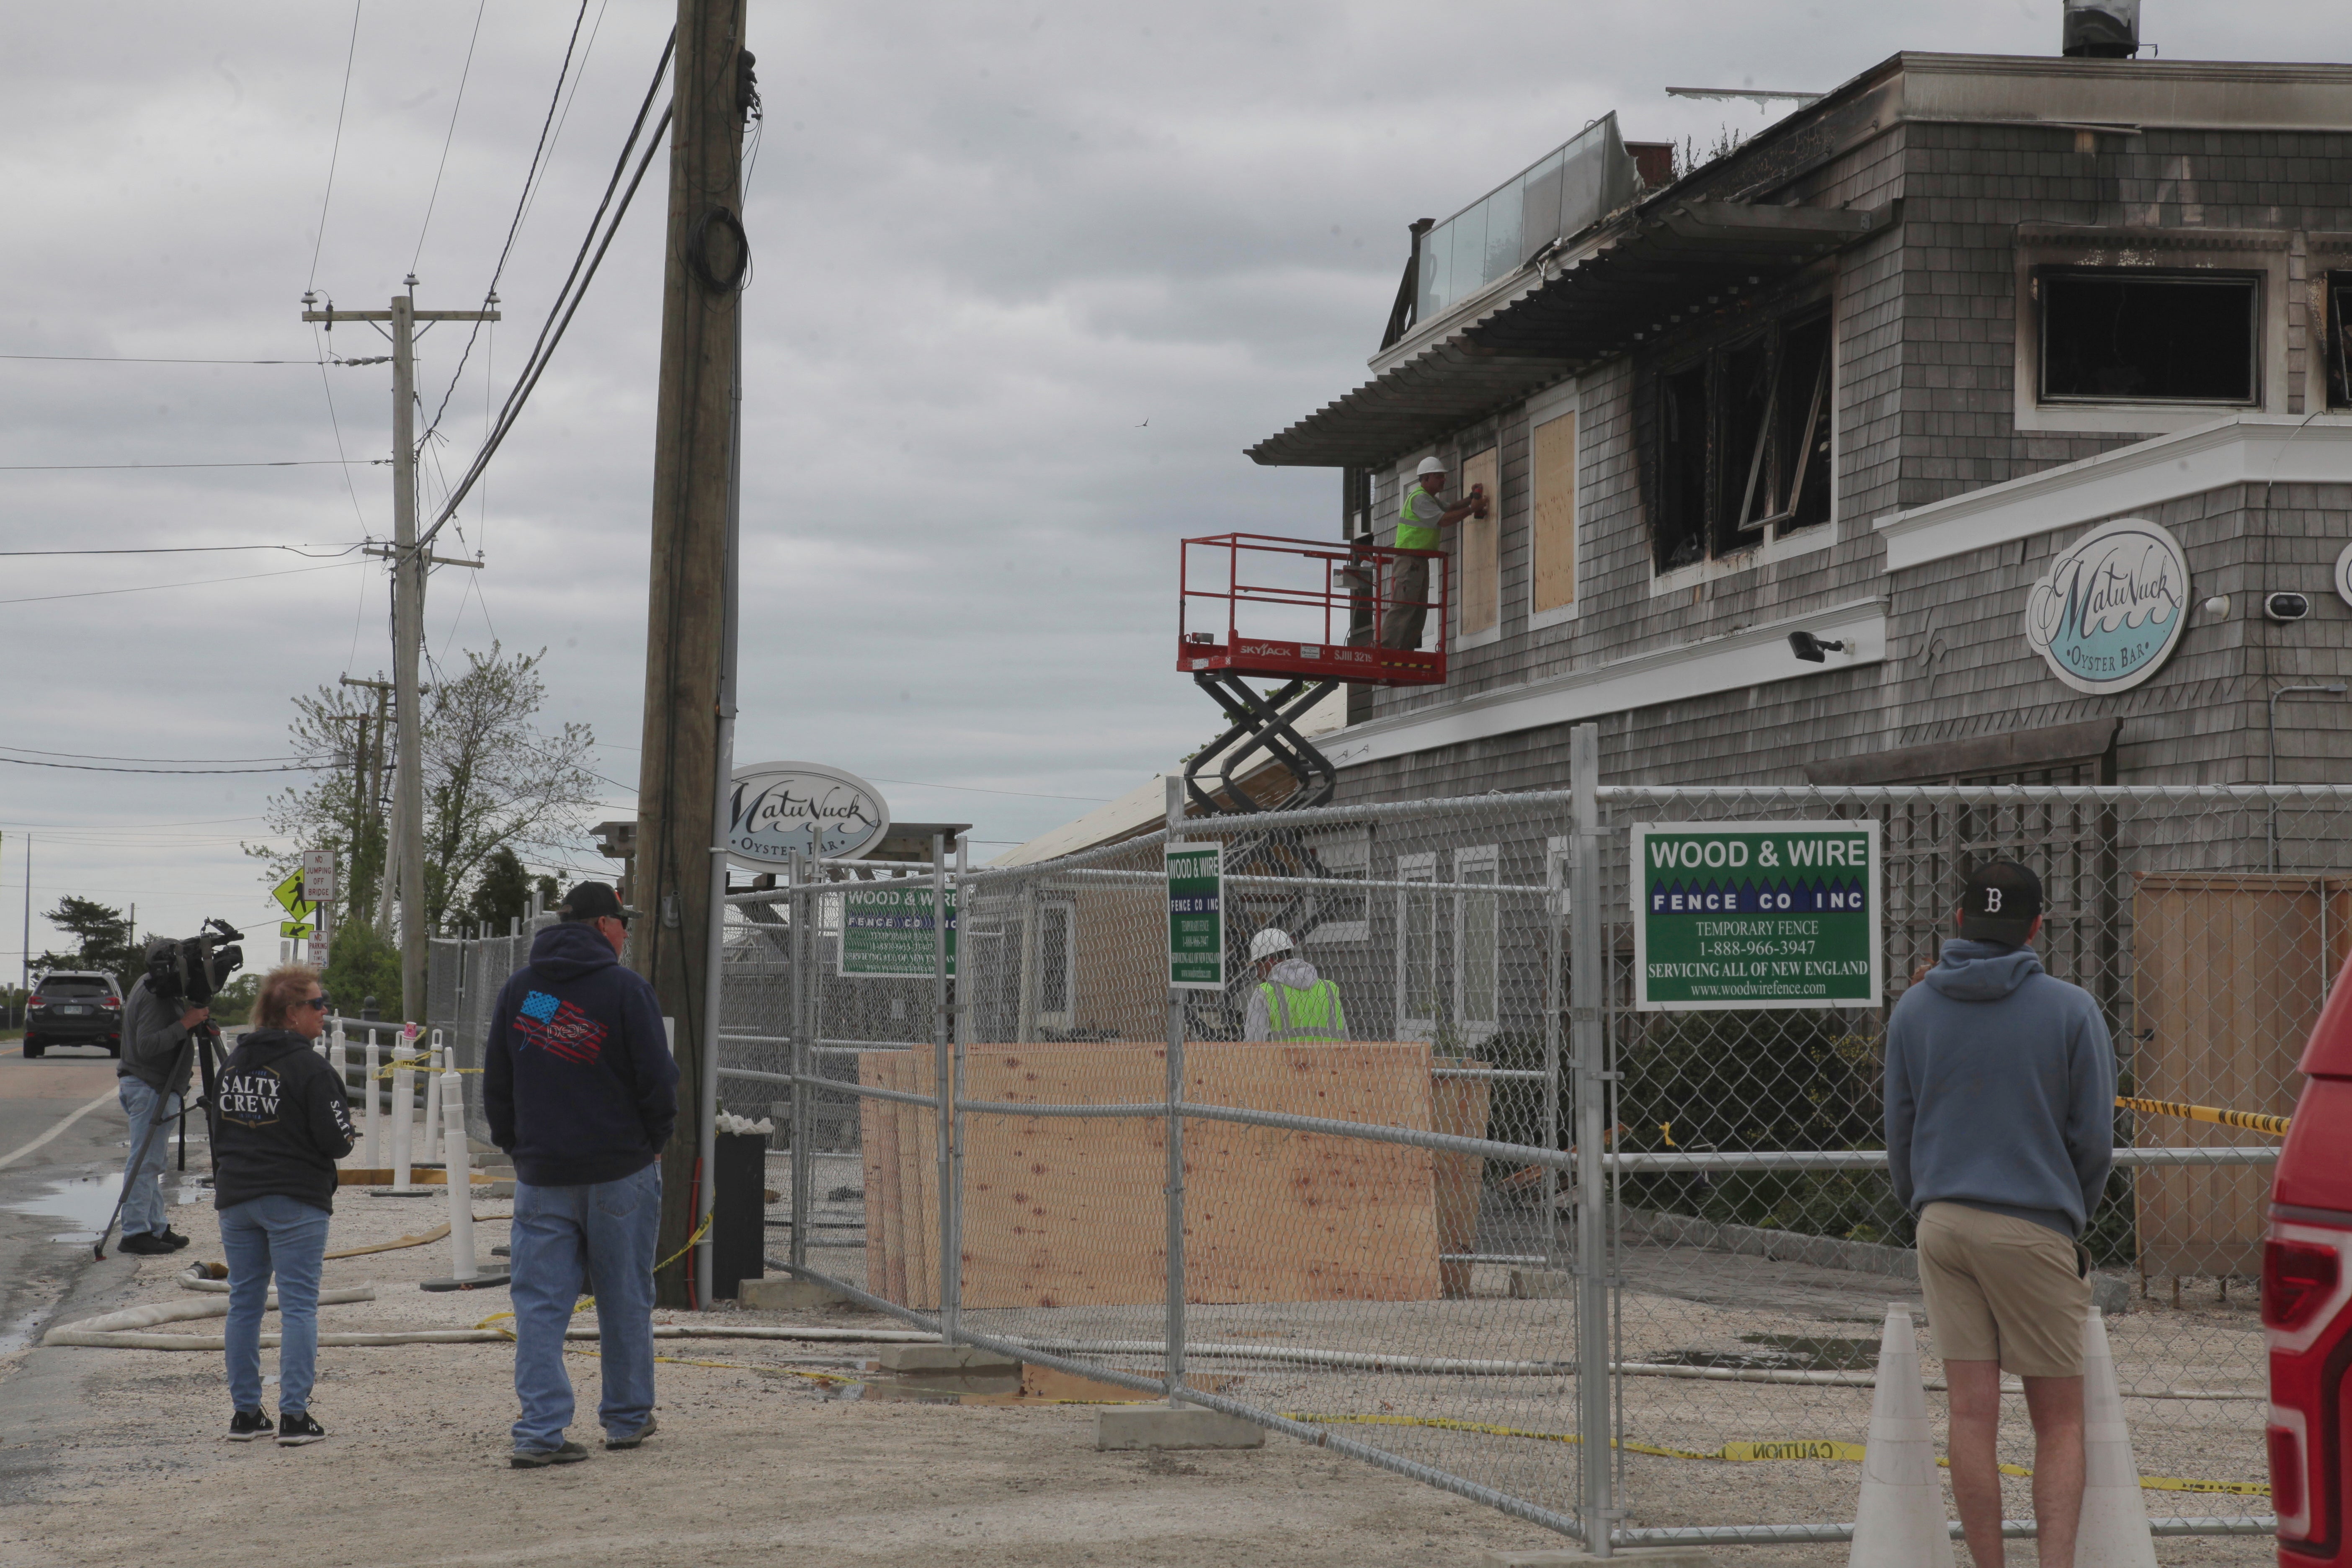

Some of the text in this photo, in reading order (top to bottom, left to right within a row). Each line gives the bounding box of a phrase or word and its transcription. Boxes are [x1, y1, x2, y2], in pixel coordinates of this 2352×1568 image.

[1240, 643, 1292, 656] SKYJACK
[2120, 643, 2144, 668] BAR
[1651, 840, 1866, 868] WOOD & WIRE
[1168, 856, 1218, 879] WOOD & WIRE
[848, 890, 900, 905] WOOD
[920, 892, 956, 906] WRE
[1171, 898, 1218, 912] FENCE CO INC
[1654, 892, 1862, 910] FENCE CO INC
[1984, 888, 2002, 913] B
[849, 918, 892, 926] FENCE
[1181, 920, 1209, 931] TEMPORARY FENCE
[1696, 921, 1819, 936] TEMPORARY FENCE
[1700, 941, 1816, 956] 1-888-966-3947
[1648, 961, 1868, 978] SERVICING ALL OF NEW ENGLAND
[1691, 980, 1826, 996] www.woodwirefence.com
[220, 1075, 280, 1096] SALTY
[219, 1094, 280, 1114] CREW
